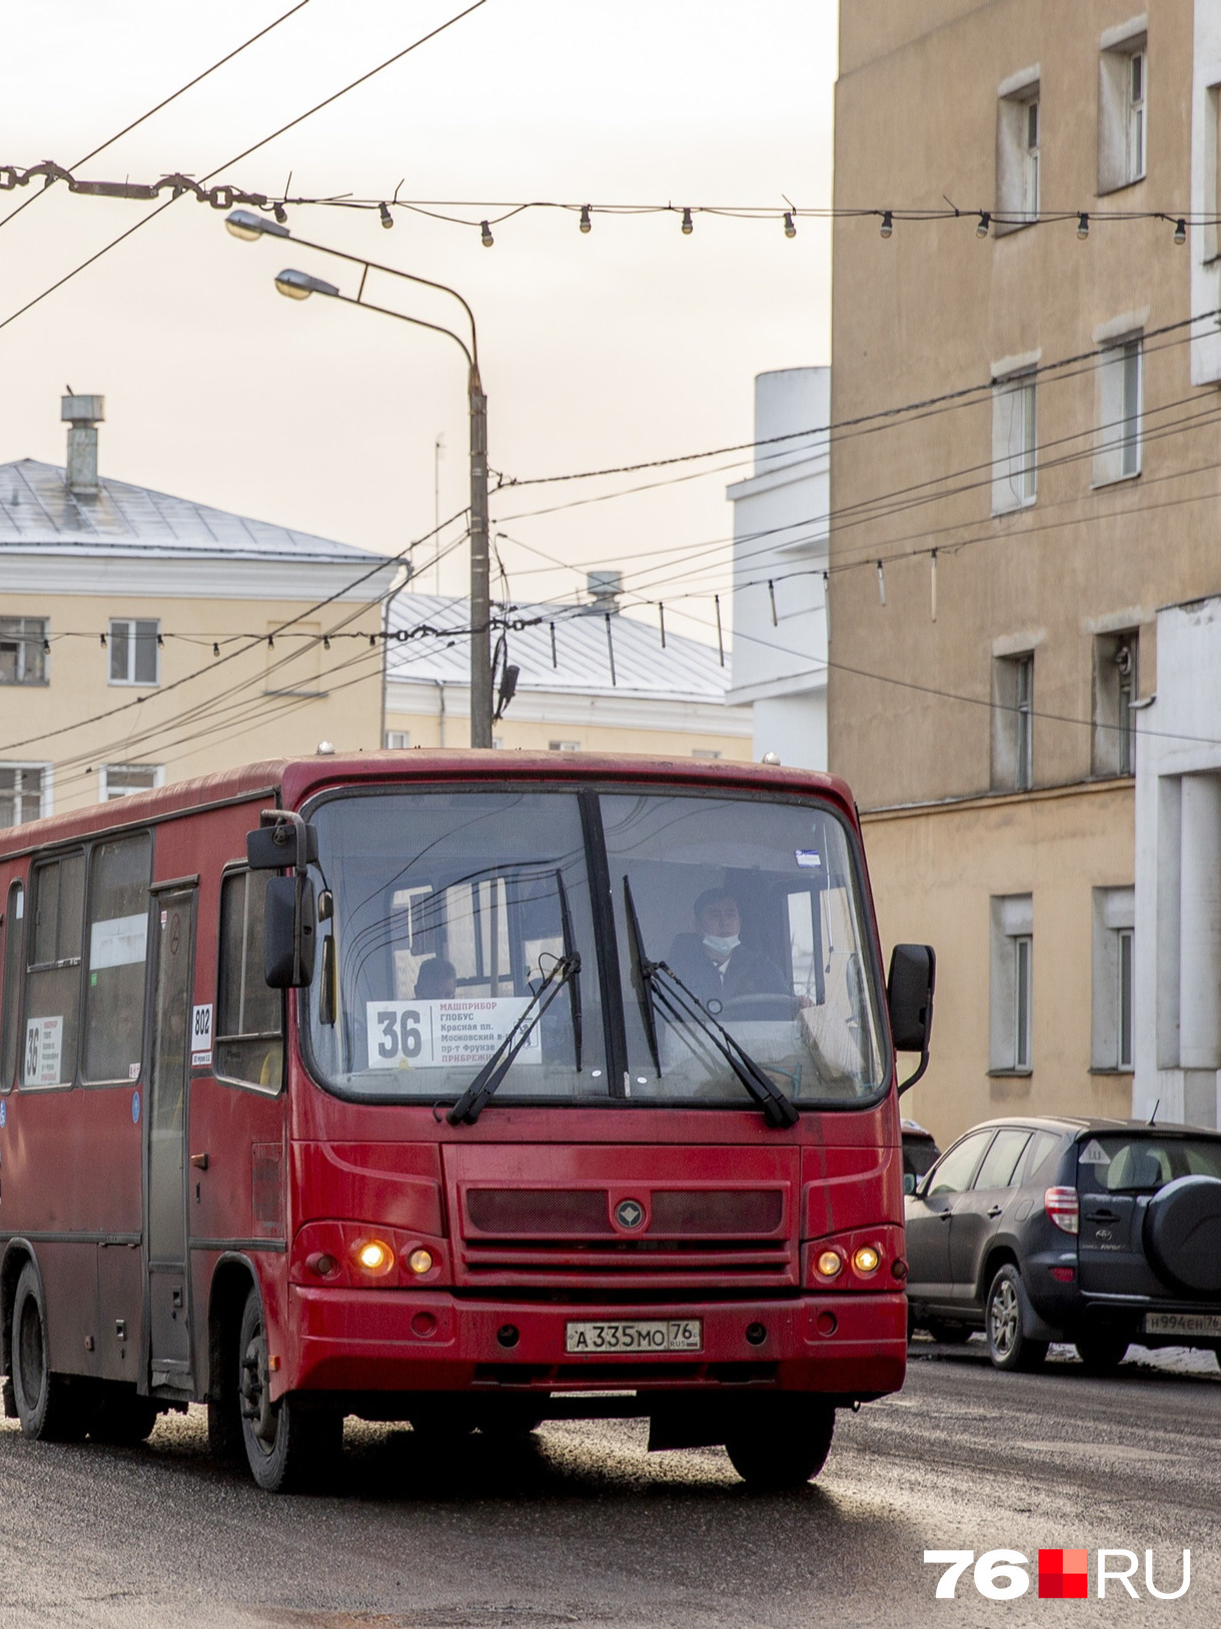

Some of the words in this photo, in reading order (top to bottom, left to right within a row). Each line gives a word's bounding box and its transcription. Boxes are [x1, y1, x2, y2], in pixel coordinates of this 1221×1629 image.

[440, 1002, 497, 1011] МАШПРИБОР
[440, 1013, 474, 1021] ГЛОБУС
[195, 1008, 210, 1036] 802
[441, 1024, 477, 1033] Красная
[377, 1009, 422, 1059] 36
[27, 1027, 40, 1076] 36
[463, 1044, 495, 1053] Фрунзе
[442, 1054, 495, 1063] ПРИБРЕЖН
[671, 1323, 692, 1340] 76
